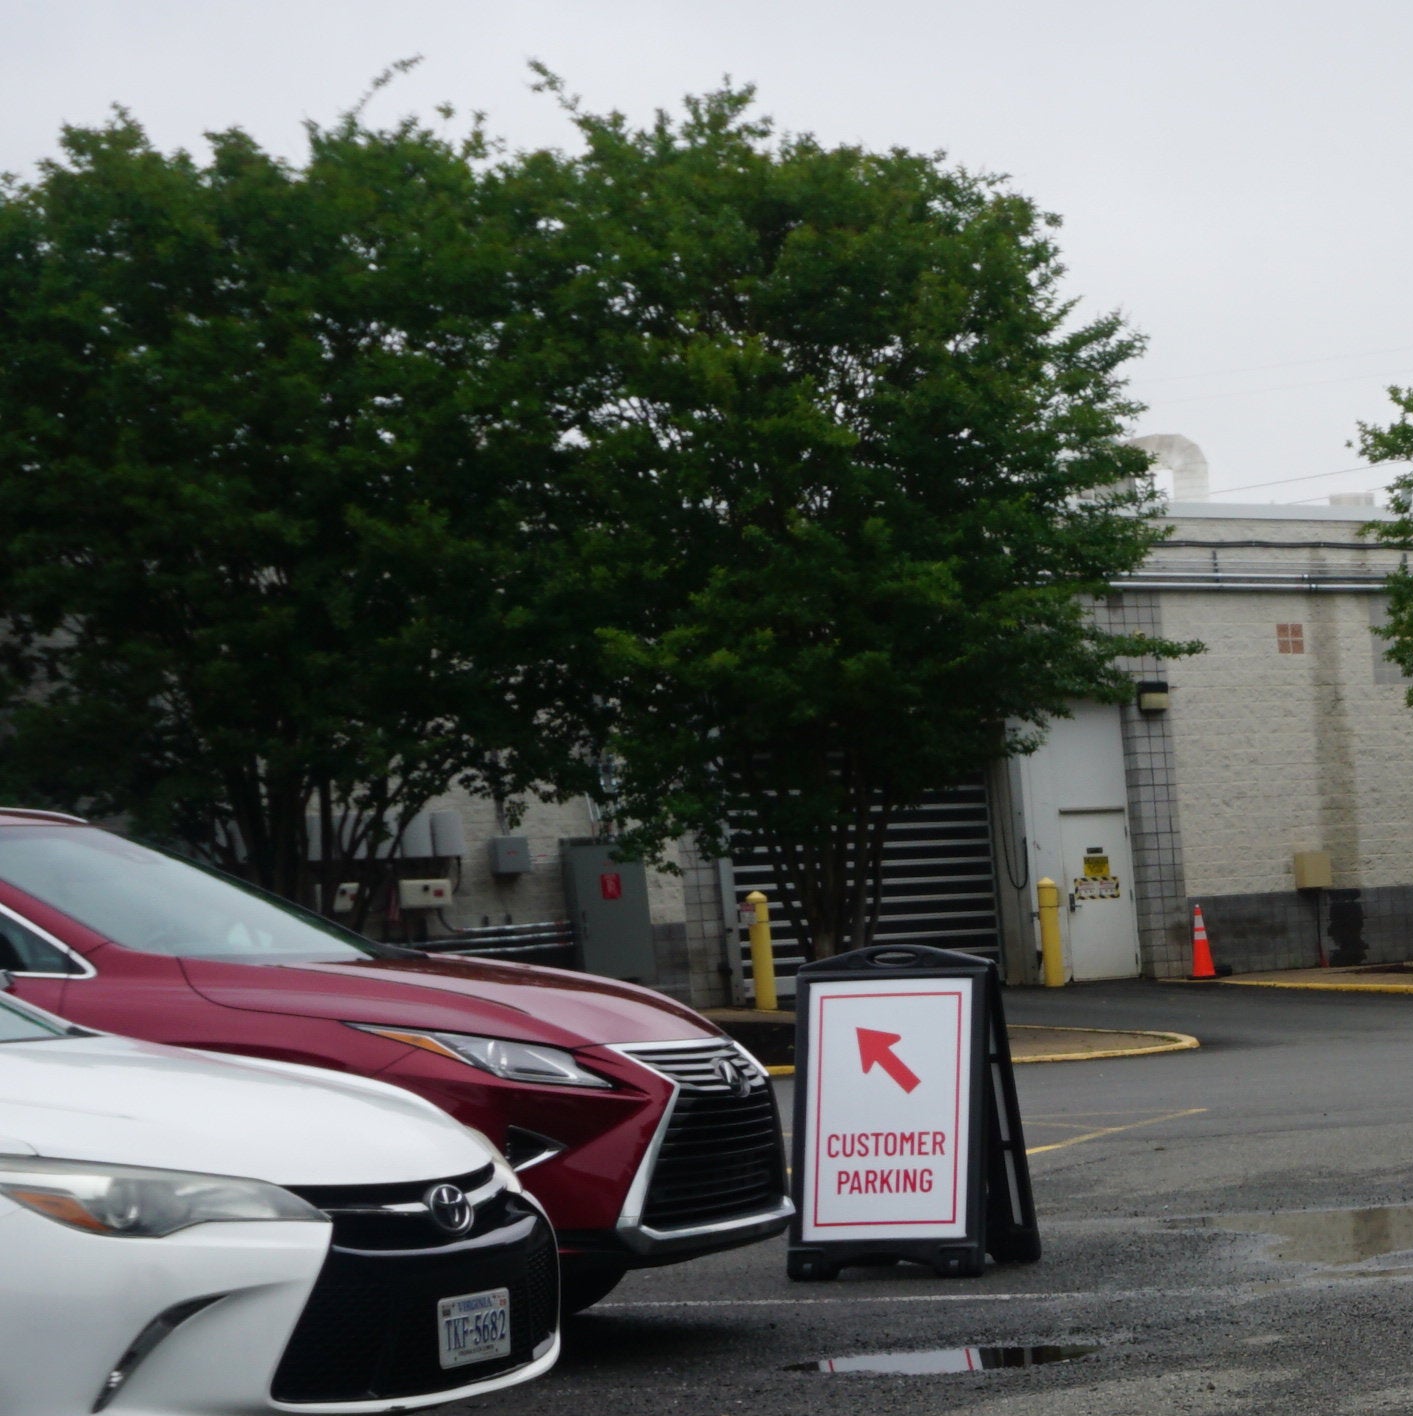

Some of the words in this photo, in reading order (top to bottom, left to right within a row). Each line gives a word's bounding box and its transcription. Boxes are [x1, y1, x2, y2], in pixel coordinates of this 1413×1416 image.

[827, 1131, 946, 1159] CUSTOMER
[836, 1168, 933, 1195] PARKING
[457, 1296, 493, 1312] VIRGINIA
